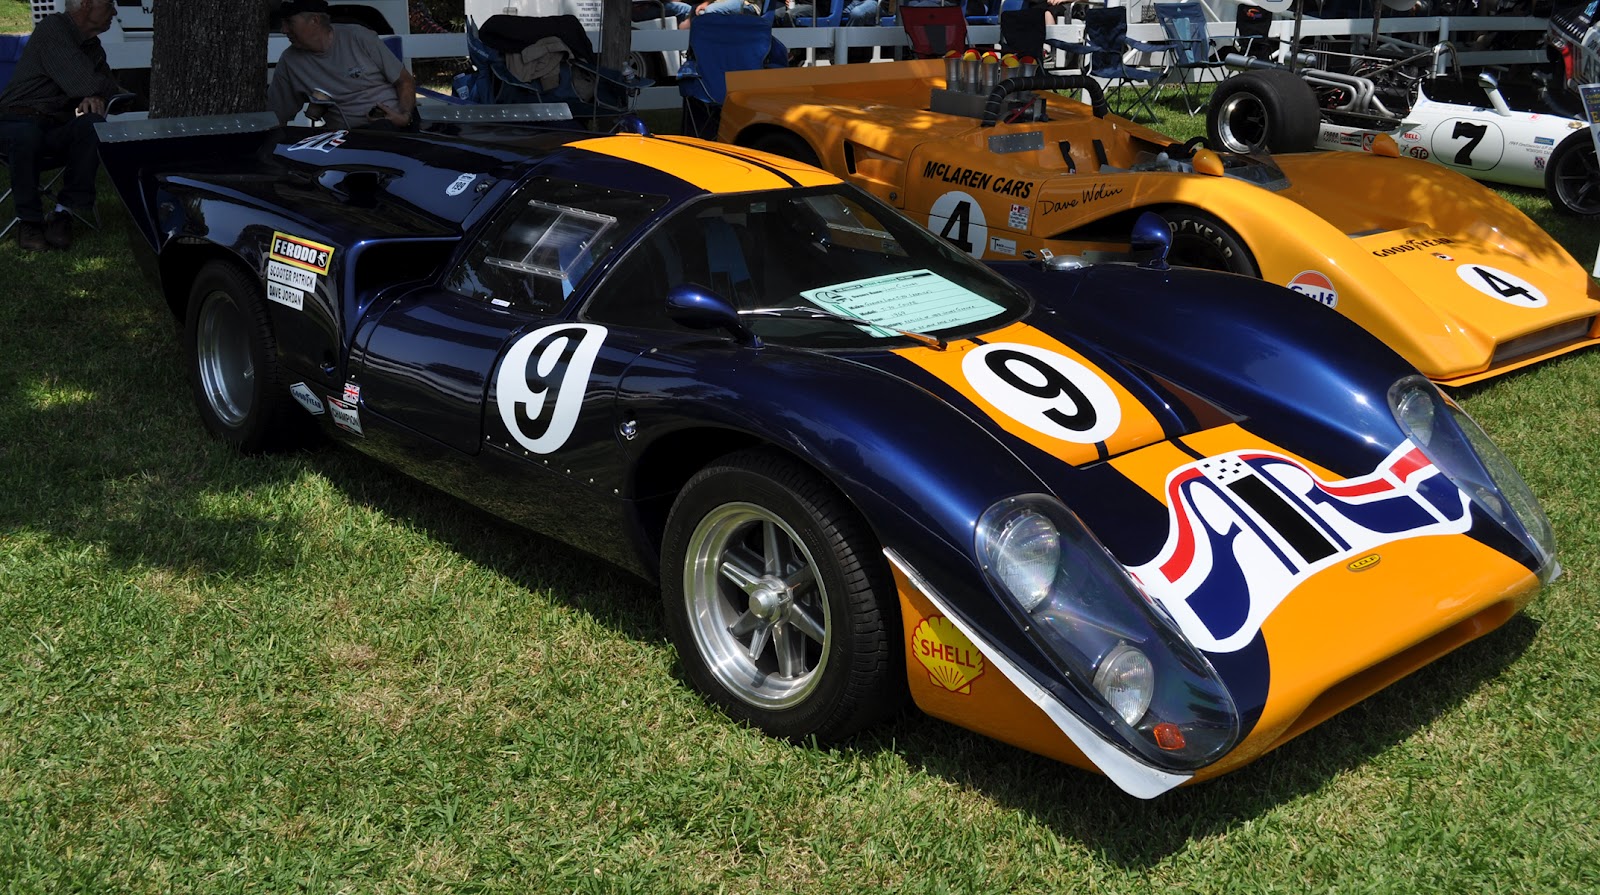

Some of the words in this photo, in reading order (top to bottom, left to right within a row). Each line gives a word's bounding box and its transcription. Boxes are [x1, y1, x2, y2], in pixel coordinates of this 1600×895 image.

[1403, 132, 1419, 140] BELL
[1451, 121, 1488, 166] 7
[1411, 147, 1428, 158] STP
[992, 177, 1034, 199] CARS
[1039, 200, 1079, 216] Dave
[940, 200, 973, 253] 4
[274, 239, 317, 264] FERODO
[269, 264, 292, 281] SCOOTER
[292, 270, 314, 288] PATRICK
[1471, 266, 1539, 302] 4
[269, 284, 282, 299] DAVE
[282, 289, 302, 306] JORDAN
[514, 327, 588, 440] 9
[984, 349, 1097, 432] 9
[331, 406, 360, 428] CHAMPION
[921, 639, 976, 668] SHELL
